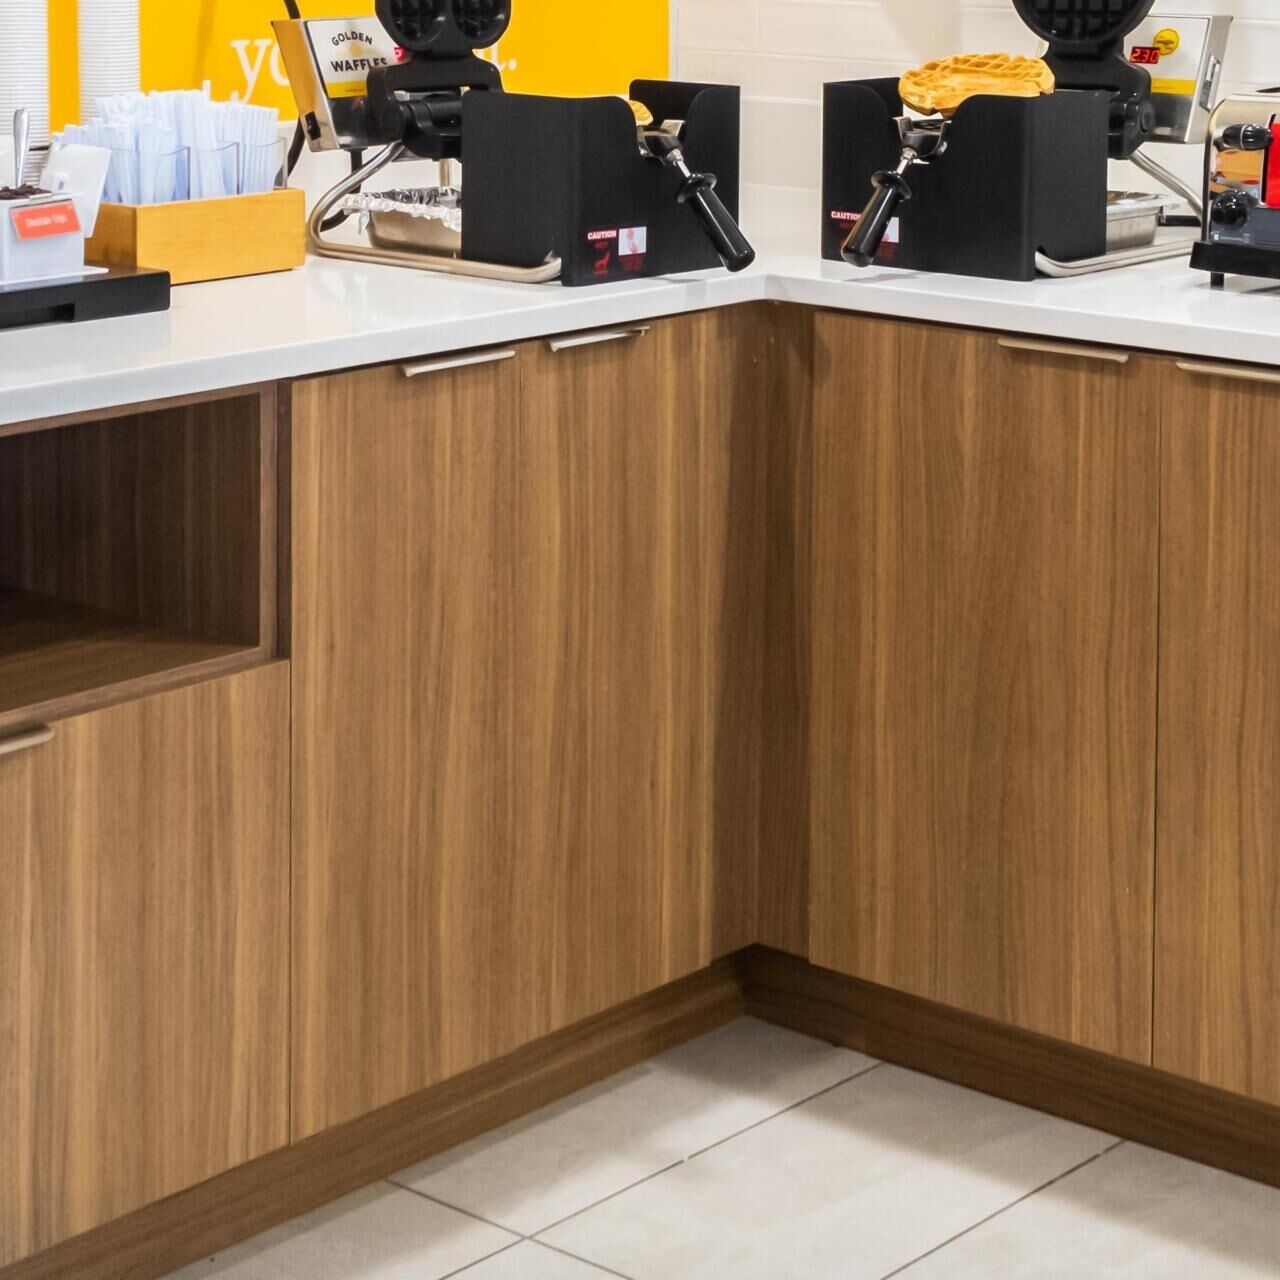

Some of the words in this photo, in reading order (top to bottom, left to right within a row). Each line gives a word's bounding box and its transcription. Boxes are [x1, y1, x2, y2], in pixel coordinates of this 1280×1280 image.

[331, 30, 373, 47] GOLDEN
[331, 57, 388, 73] WAFFLES
[830, 210, 862, 221] CAUTIO
[587, 229, 617, 240] CAUTION
